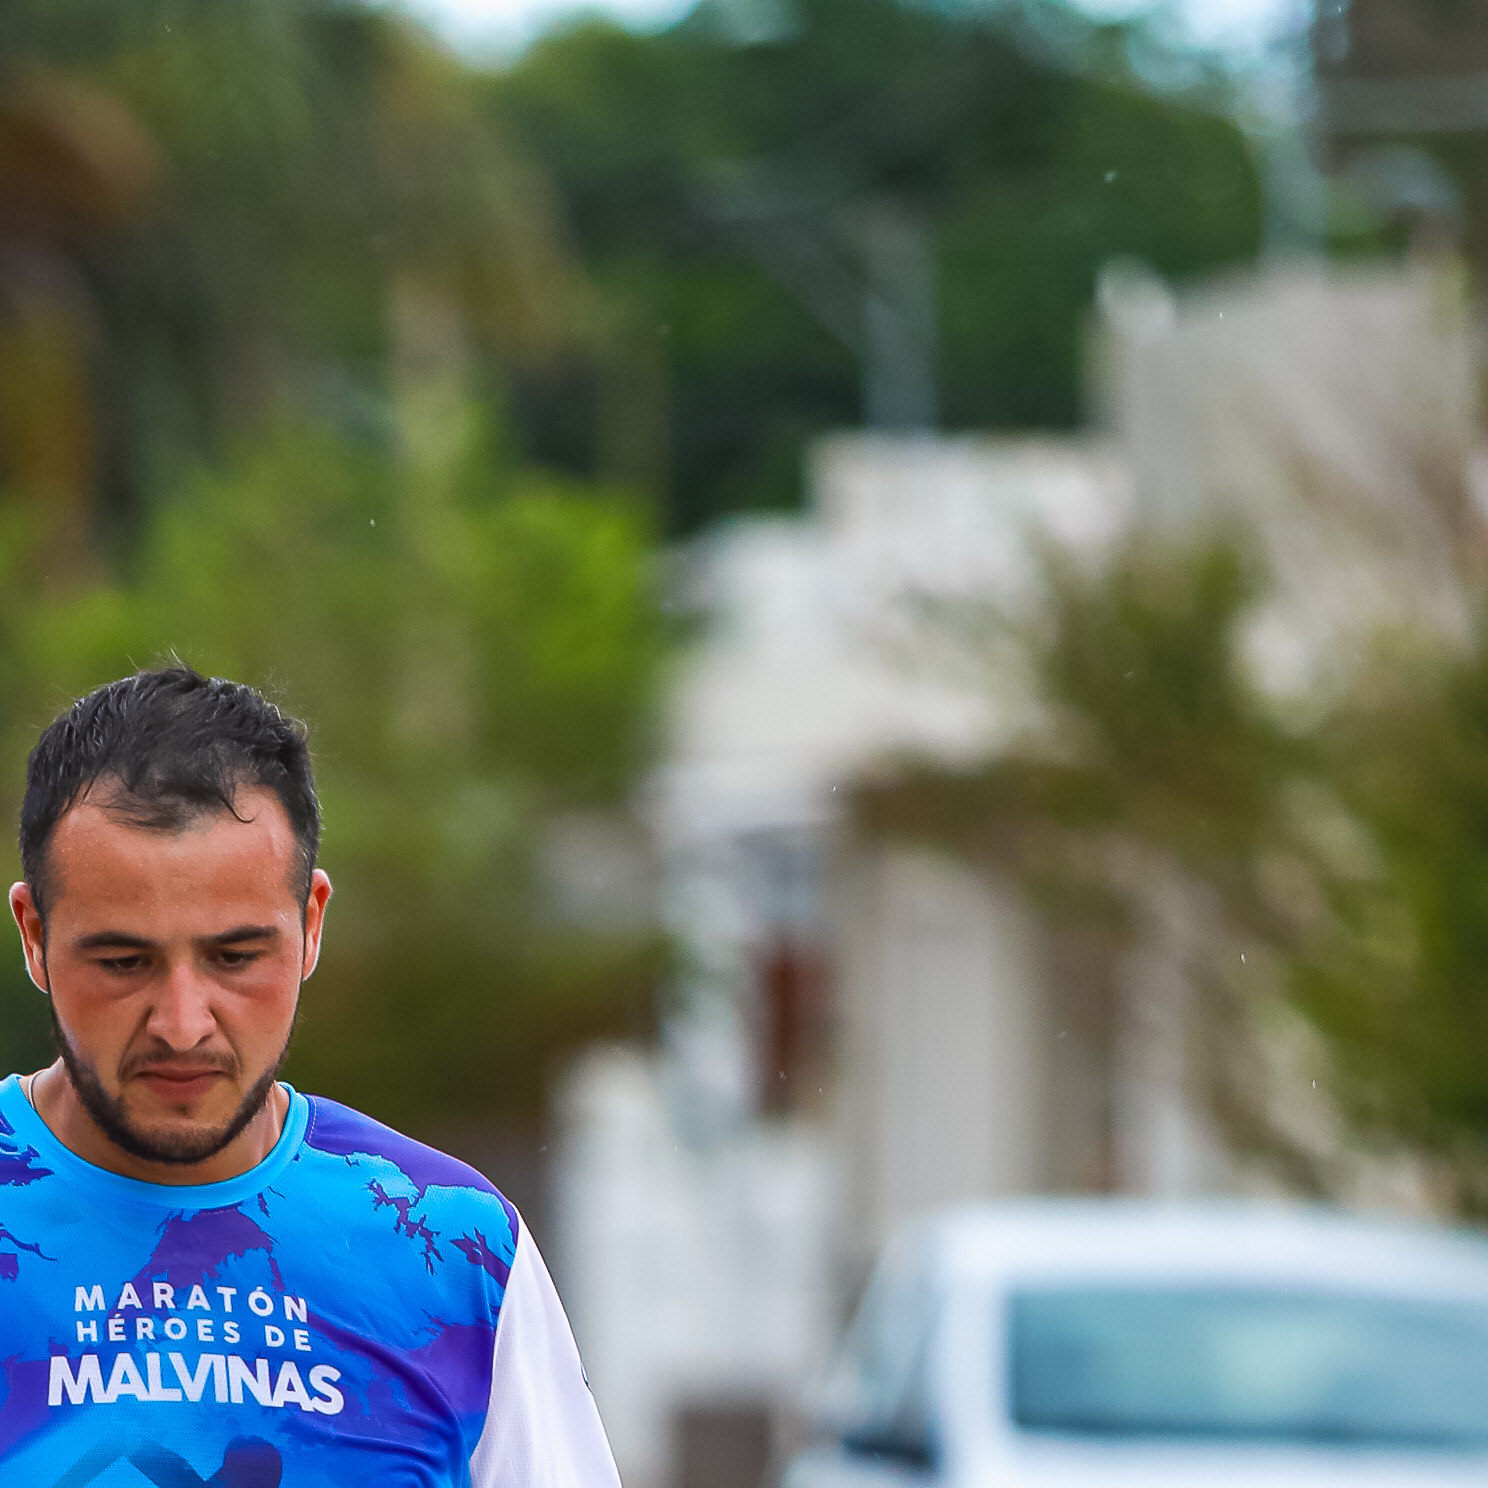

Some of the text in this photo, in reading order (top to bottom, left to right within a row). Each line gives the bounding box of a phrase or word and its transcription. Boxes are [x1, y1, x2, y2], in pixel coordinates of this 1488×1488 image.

[74, 1282, 308, 1323] MARATÓN
[76, 1314, 312, 1352] HÉROES DE
[47, 1352, 344, 1416] MALVINAS
